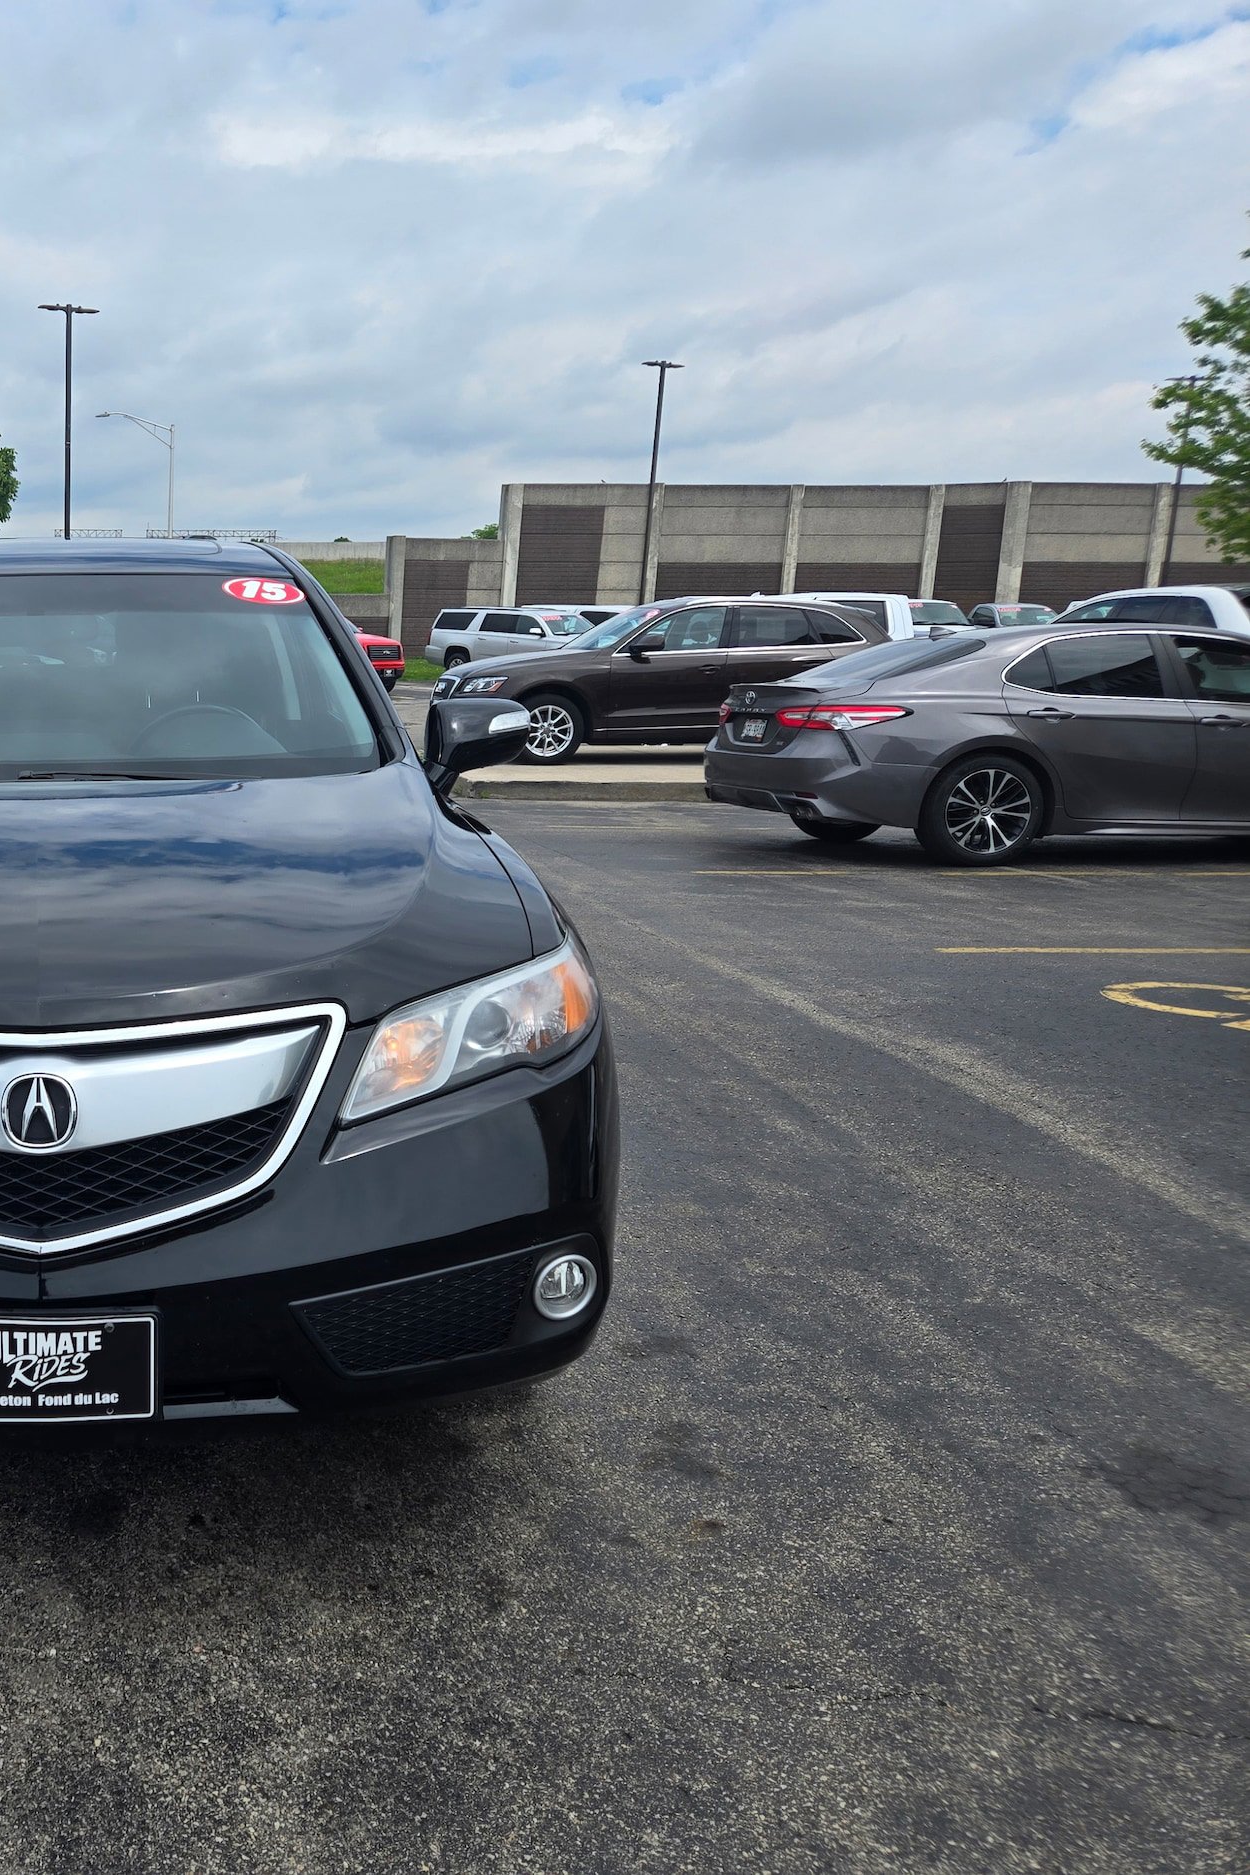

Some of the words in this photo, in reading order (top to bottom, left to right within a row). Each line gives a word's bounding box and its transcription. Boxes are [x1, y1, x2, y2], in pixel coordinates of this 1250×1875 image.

[241, 580, 287, 601] 15
[6, 1352, 91, 1392] RIDES
[37, 1393, 72, 1406] Fond
[74, 1392, 92, 1406] du
[94, 1391, 120, 1405] Lac
